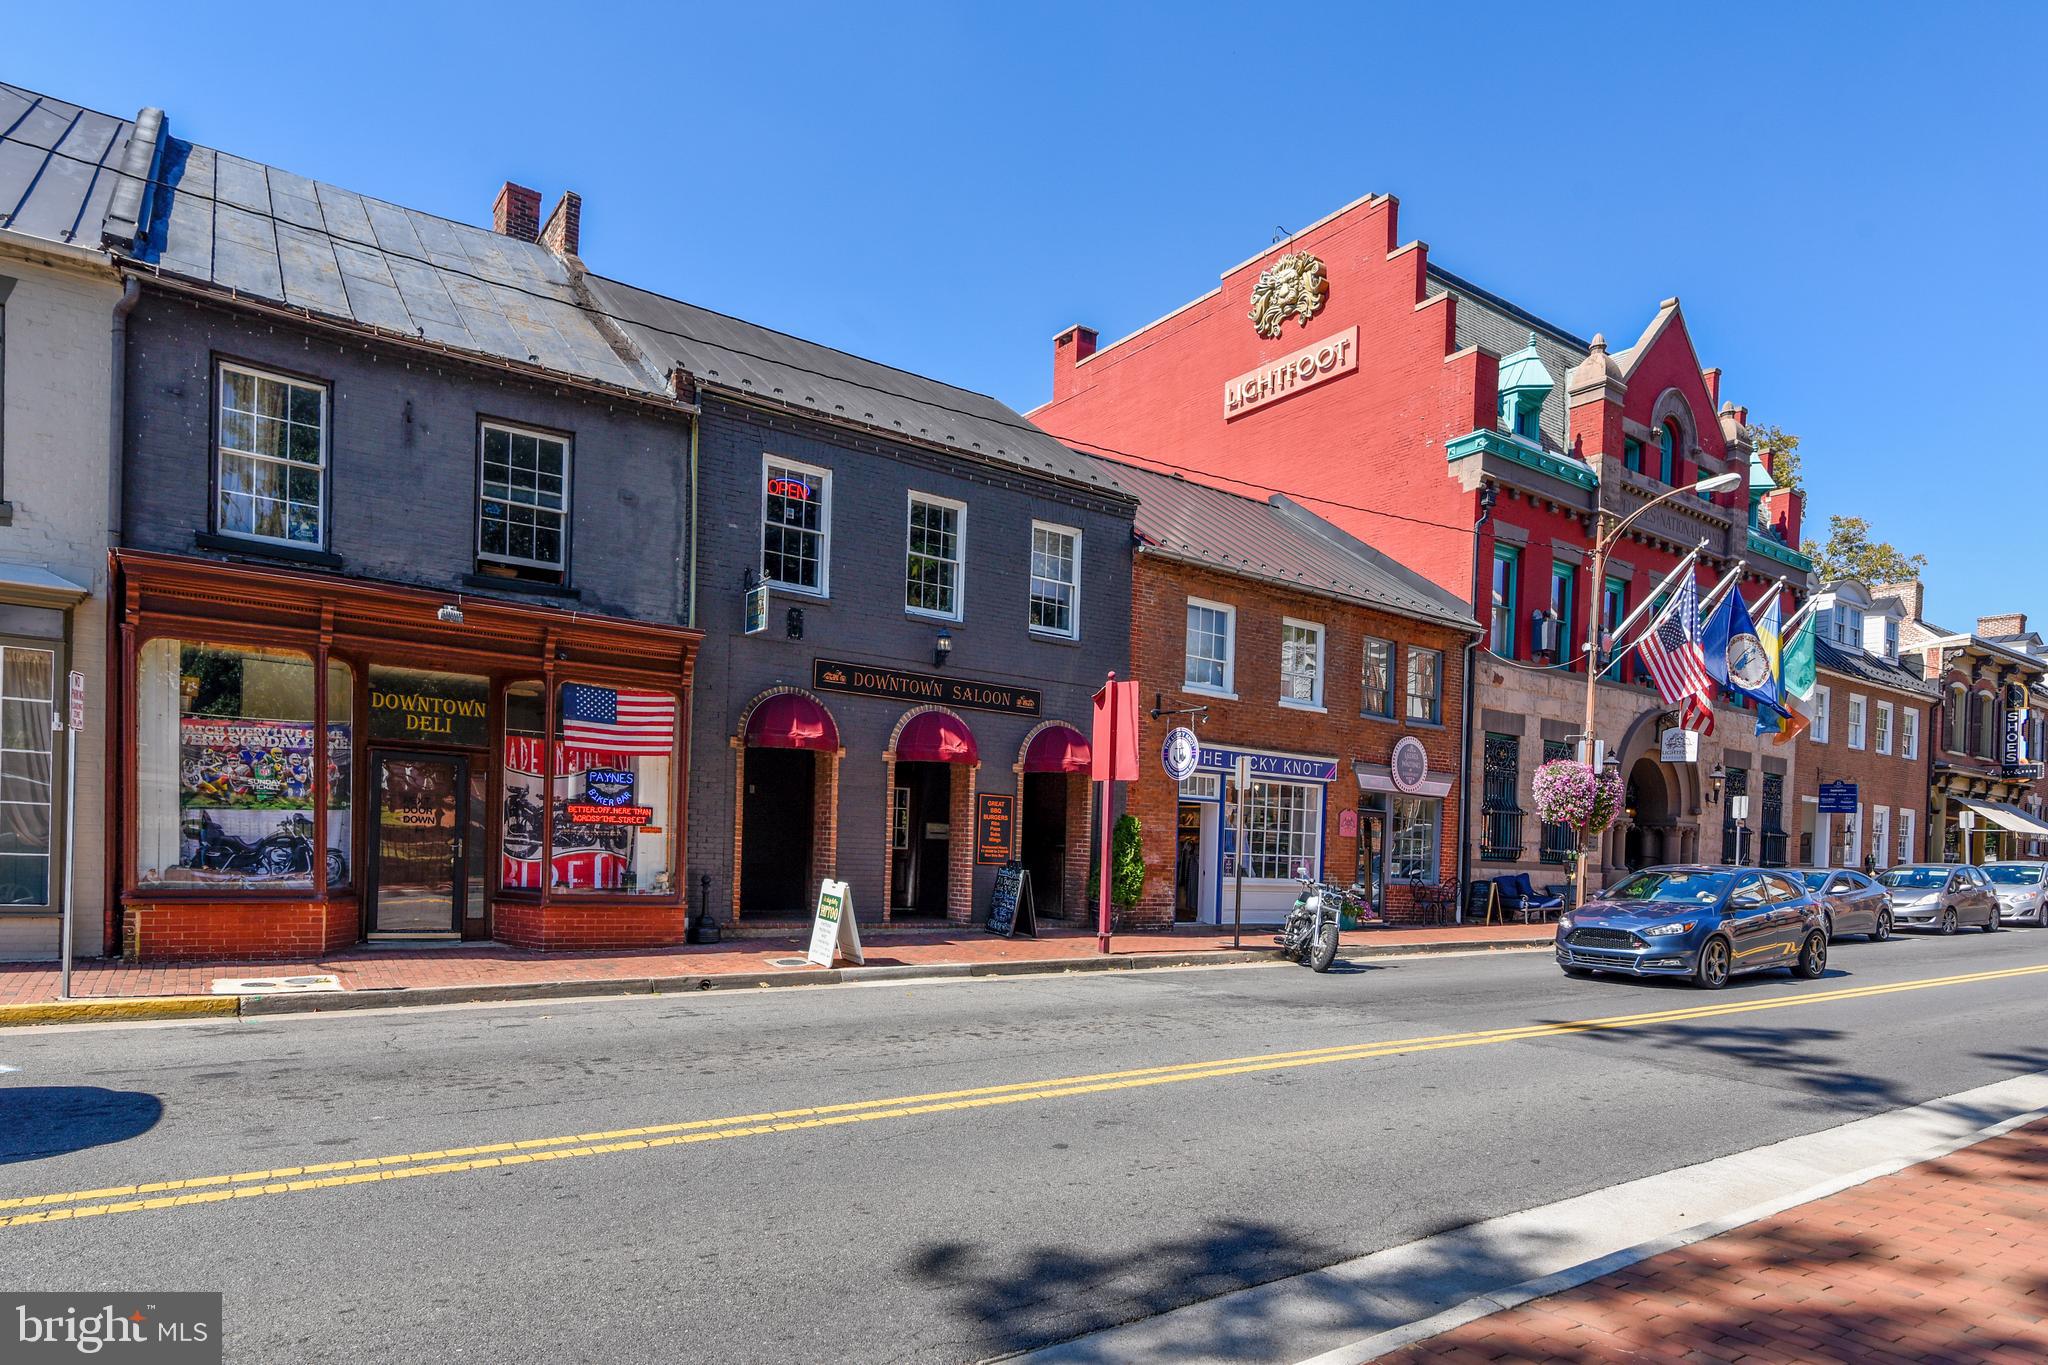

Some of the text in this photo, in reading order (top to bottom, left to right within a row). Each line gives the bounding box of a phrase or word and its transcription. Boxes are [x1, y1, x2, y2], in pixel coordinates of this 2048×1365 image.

[1226, 339, 1350, 409] LIGHTFOOT
[768, 479, 808, 500] OPEN
[853, 671, 1011, 706] DOWNTOWN SALOON
[371, 691, 487, 718] DOWNTOWN
[182, 725, 224, 736] ATCH
[228, 726, 270, 738] EVERY
[273, 728, 303, 738] LIVE
[406, 714, 452, 734] DELI
[229, 736, 300, 749] SUNDAY
[2006, 712, 2018, 763] SHOES
[1199, 750, 1321, 776] HE LCKY KNOT
[589, 772, 634, 784] PAYNES
[588, 788, 632, 806] BIKER BAR
[403, 806, 433, 815] DOOR
[568, 805, 652, 817] BETTER OFF HERE THAN
[573, 814, 646, 824] ACROSS THE STREET
[403, 815, 435, 825] DOWN
